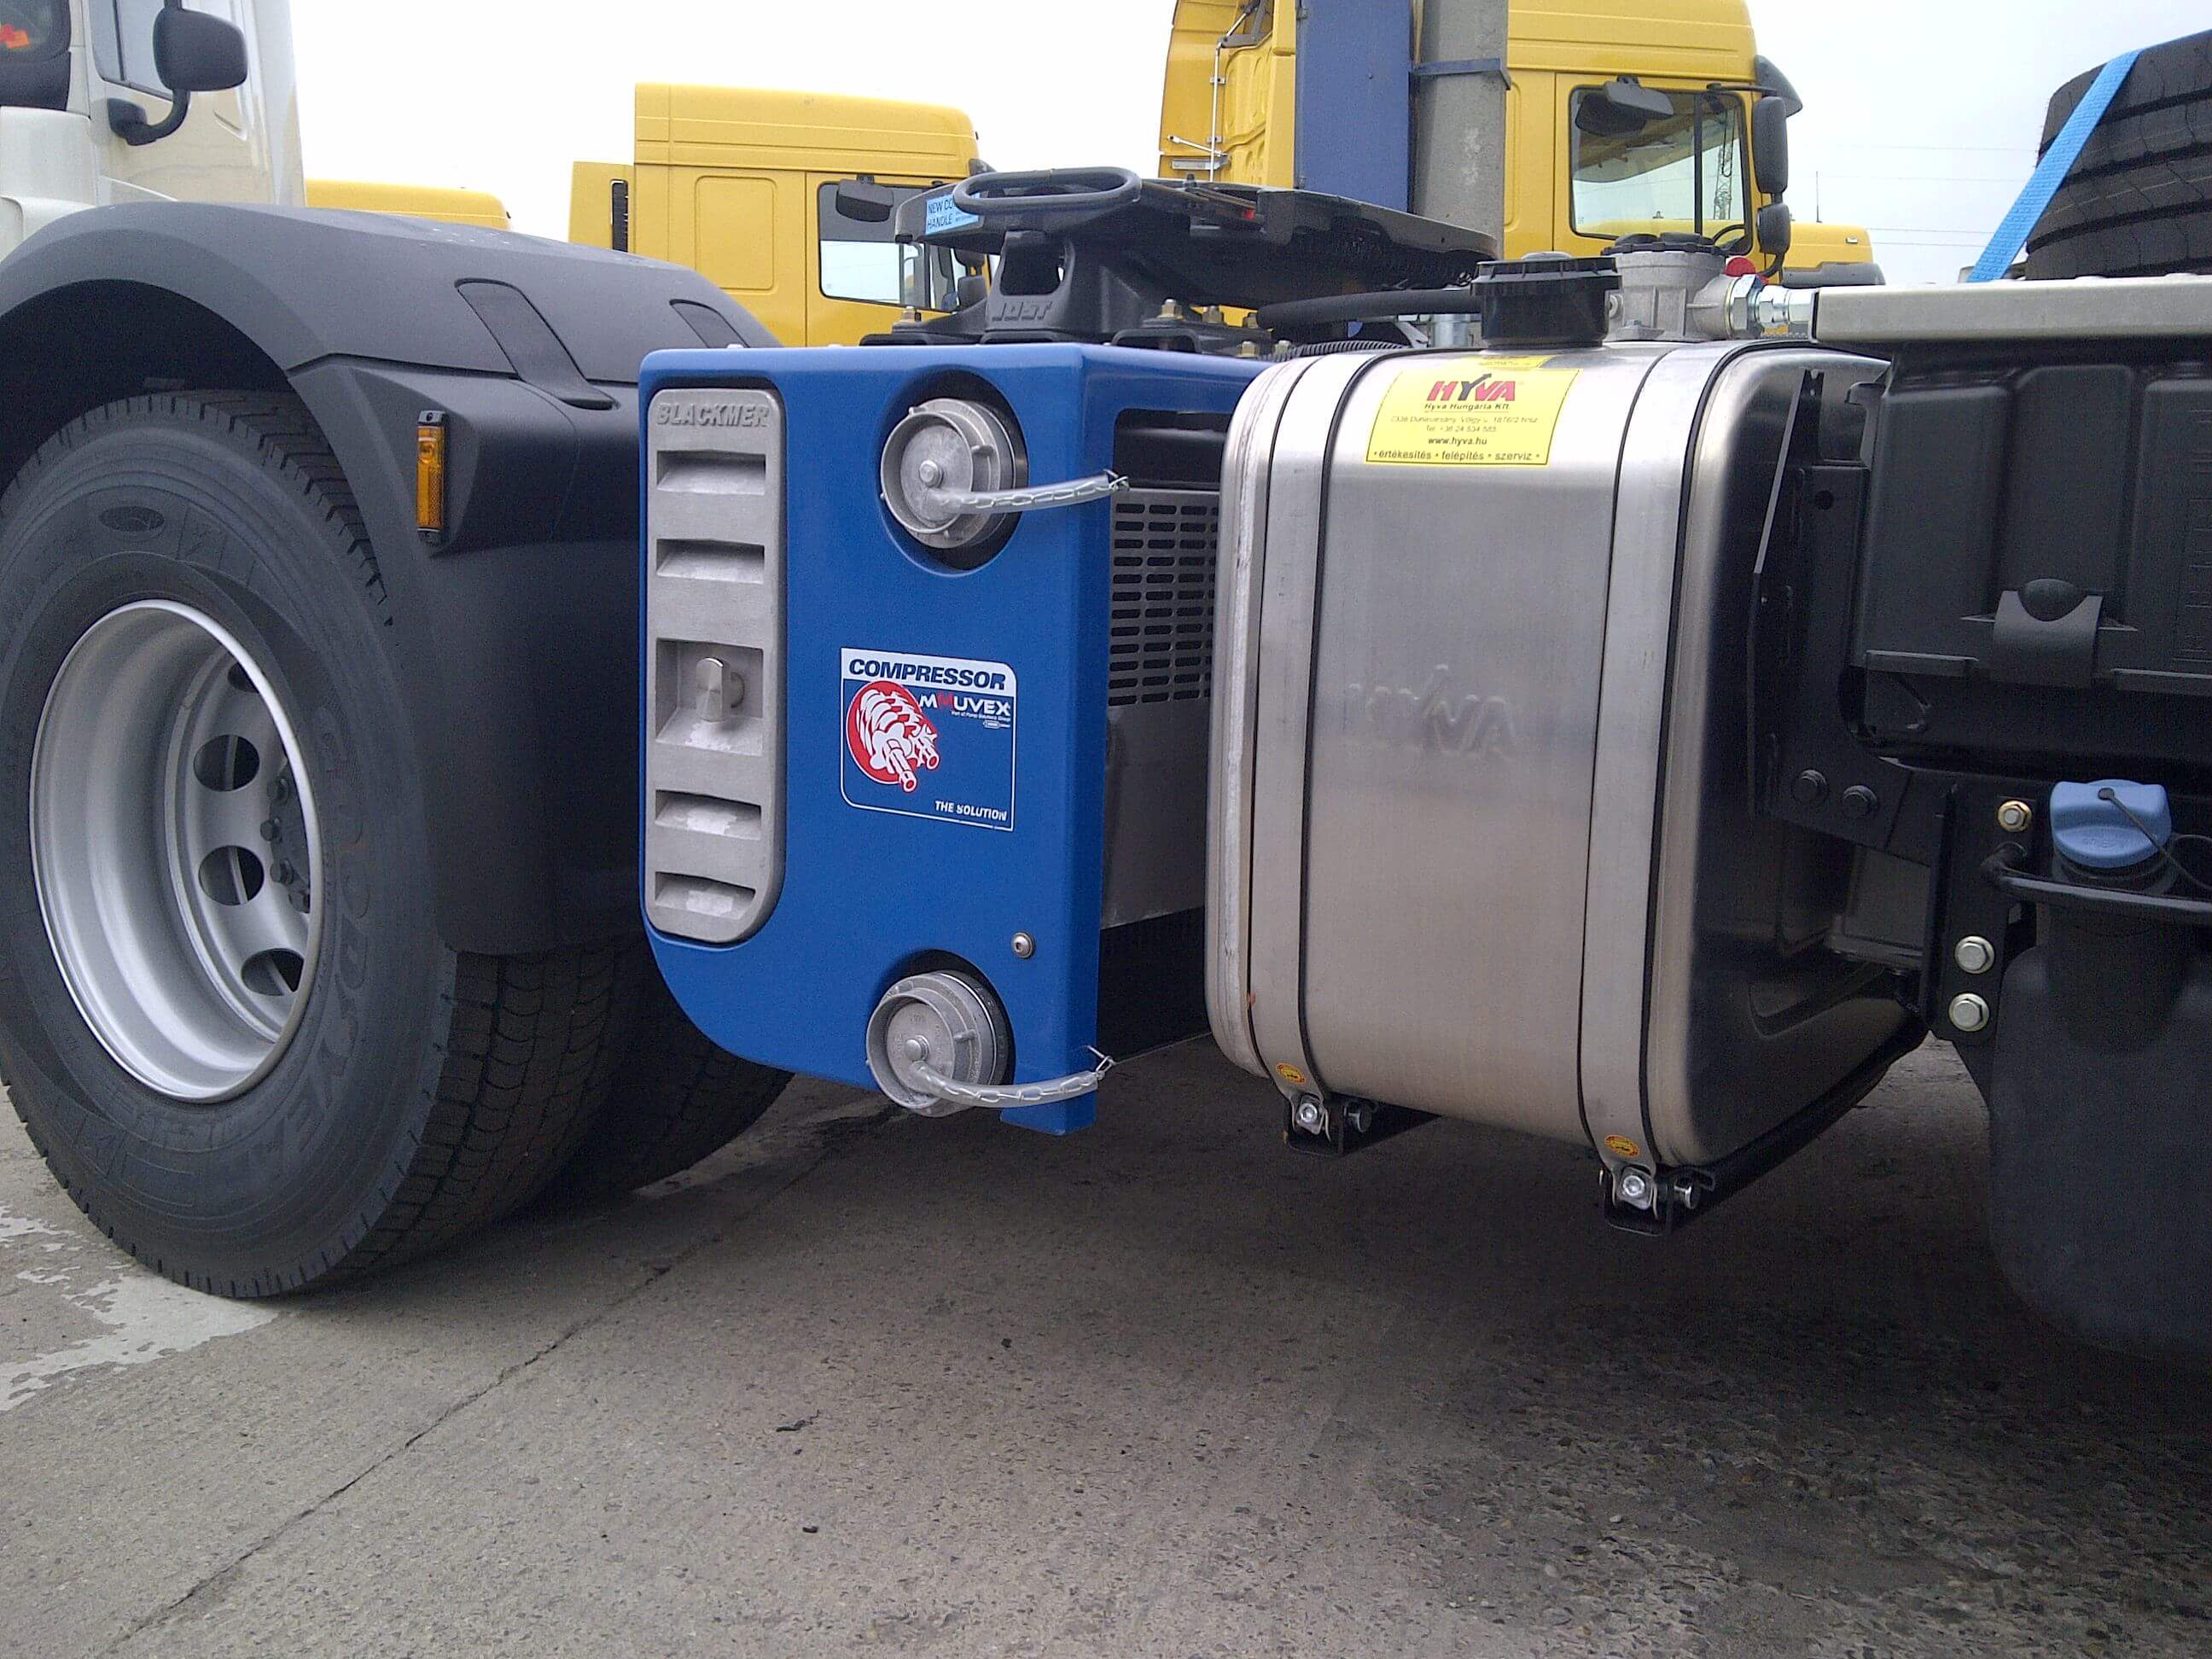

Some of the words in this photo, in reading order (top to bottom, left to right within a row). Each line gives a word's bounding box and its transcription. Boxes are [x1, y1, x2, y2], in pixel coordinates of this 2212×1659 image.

[928, 201, 943, 213] NEW
[928, 213, 953, 228] HANDLE
[1426, 373, 1516, 401] HYVA
[1424, 403, 1447, 411] Hyva
[656, 402, 770, 428] BLACKMER
[1428, 437, 1487, 446] www.hyva.hu
[1494, 452, 1533, 461] szerviz
[849, 659, 1006, 690] COMPRESSOR
[935, 800, 954, 812] THE
[957, 804, 1007, 821] SOLUTION
